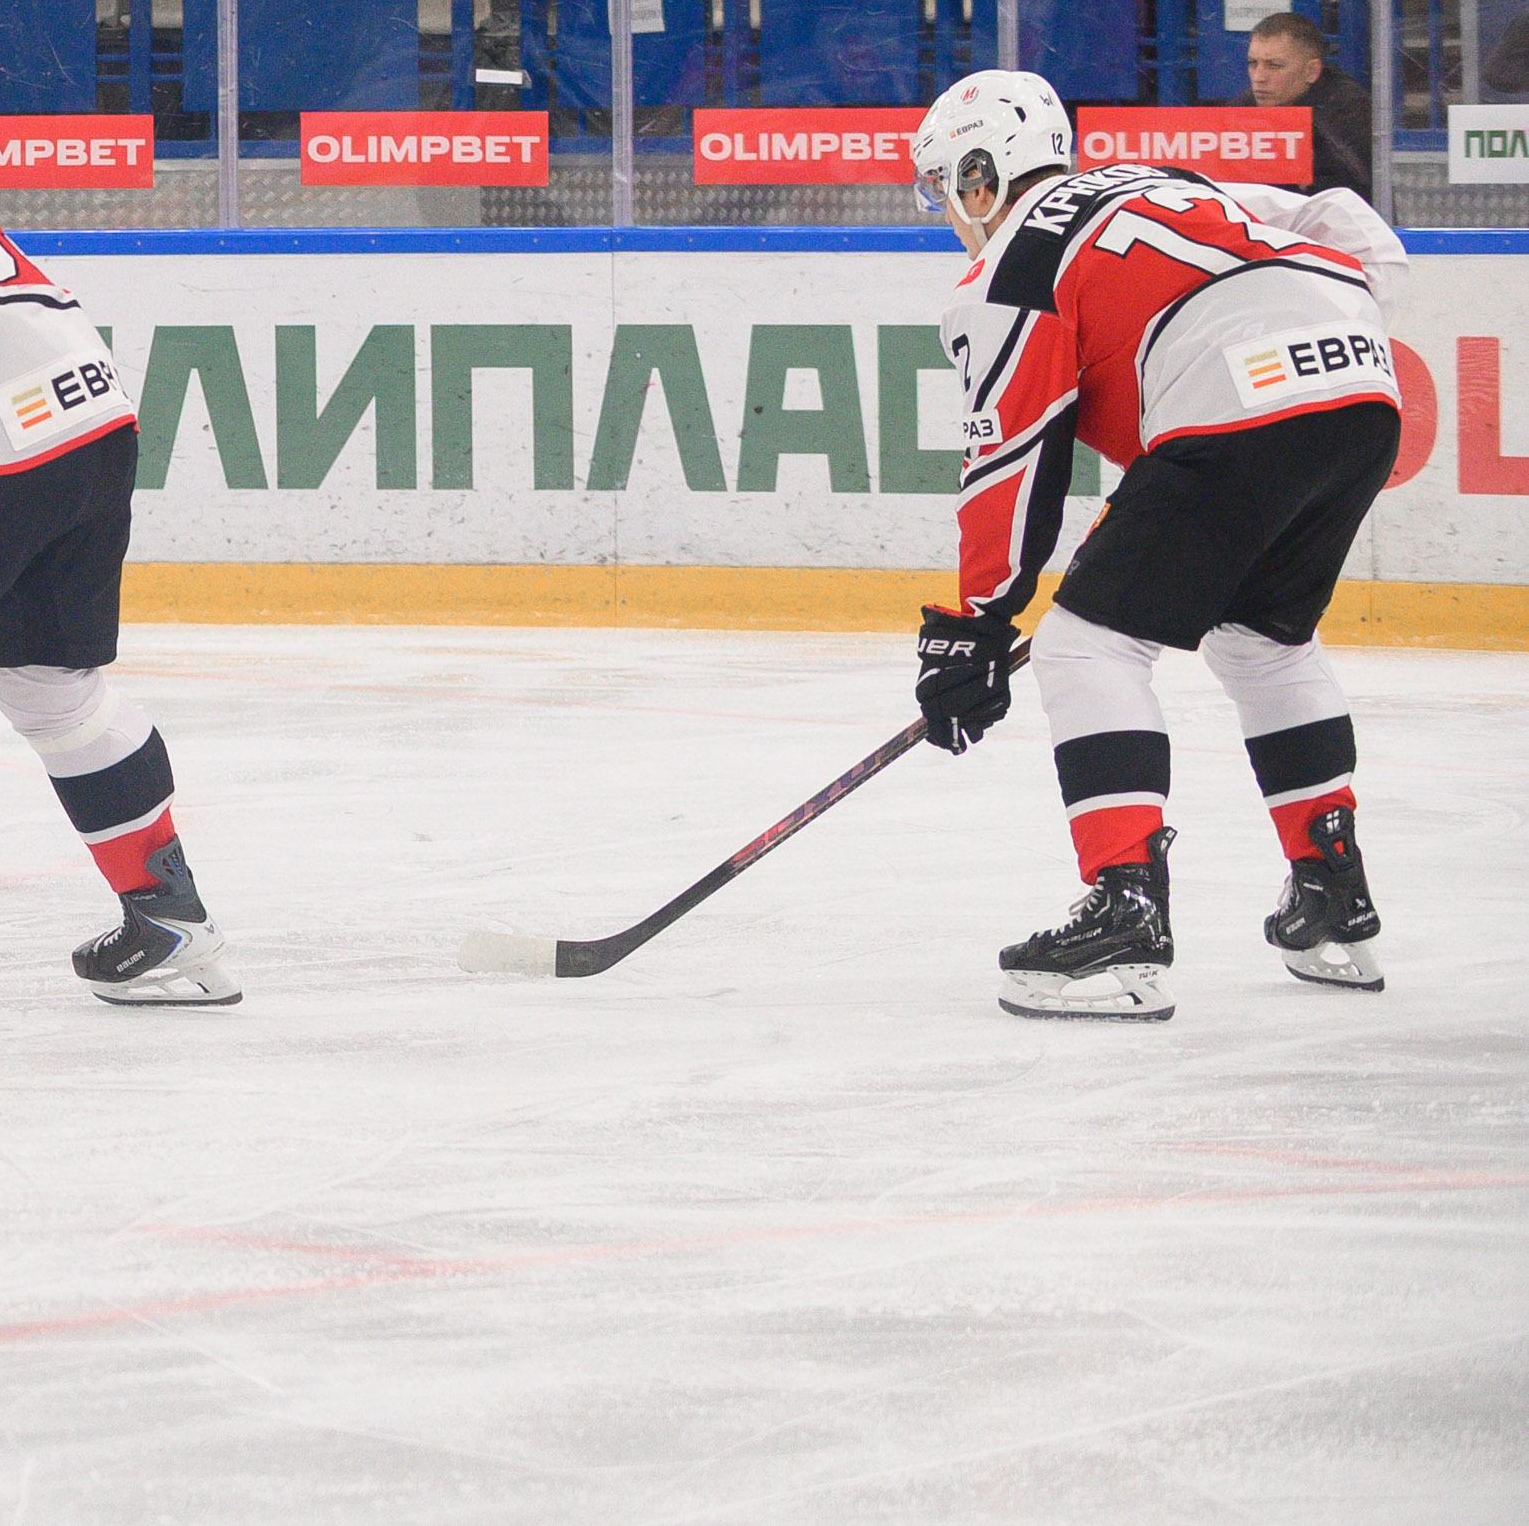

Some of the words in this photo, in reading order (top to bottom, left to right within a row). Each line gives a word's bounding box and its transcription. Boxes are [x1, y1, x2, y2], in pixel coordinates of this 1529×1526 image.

[956, 119, 985, 136] ЕВРАЗ
[306, 135, 540, 164] OLIMPBET
[700, 132, 918, 162] OLIMPBET
[1051, 132, 1066, 156] 12
[1083, 131, 1304, 161] OLIMPBET
[1094, 182, 1304, 277] 12
[952, 333, 972, 393] 2
[1287, 334, 1392, 378] ЕВРАЗ
[88, 325, 1101, 494] ЛИПЛАС
[963, 418, 994, 439] РАЗ
[918, 637, 977, 658] UER
[116, 949, 146, 973] BAUER
